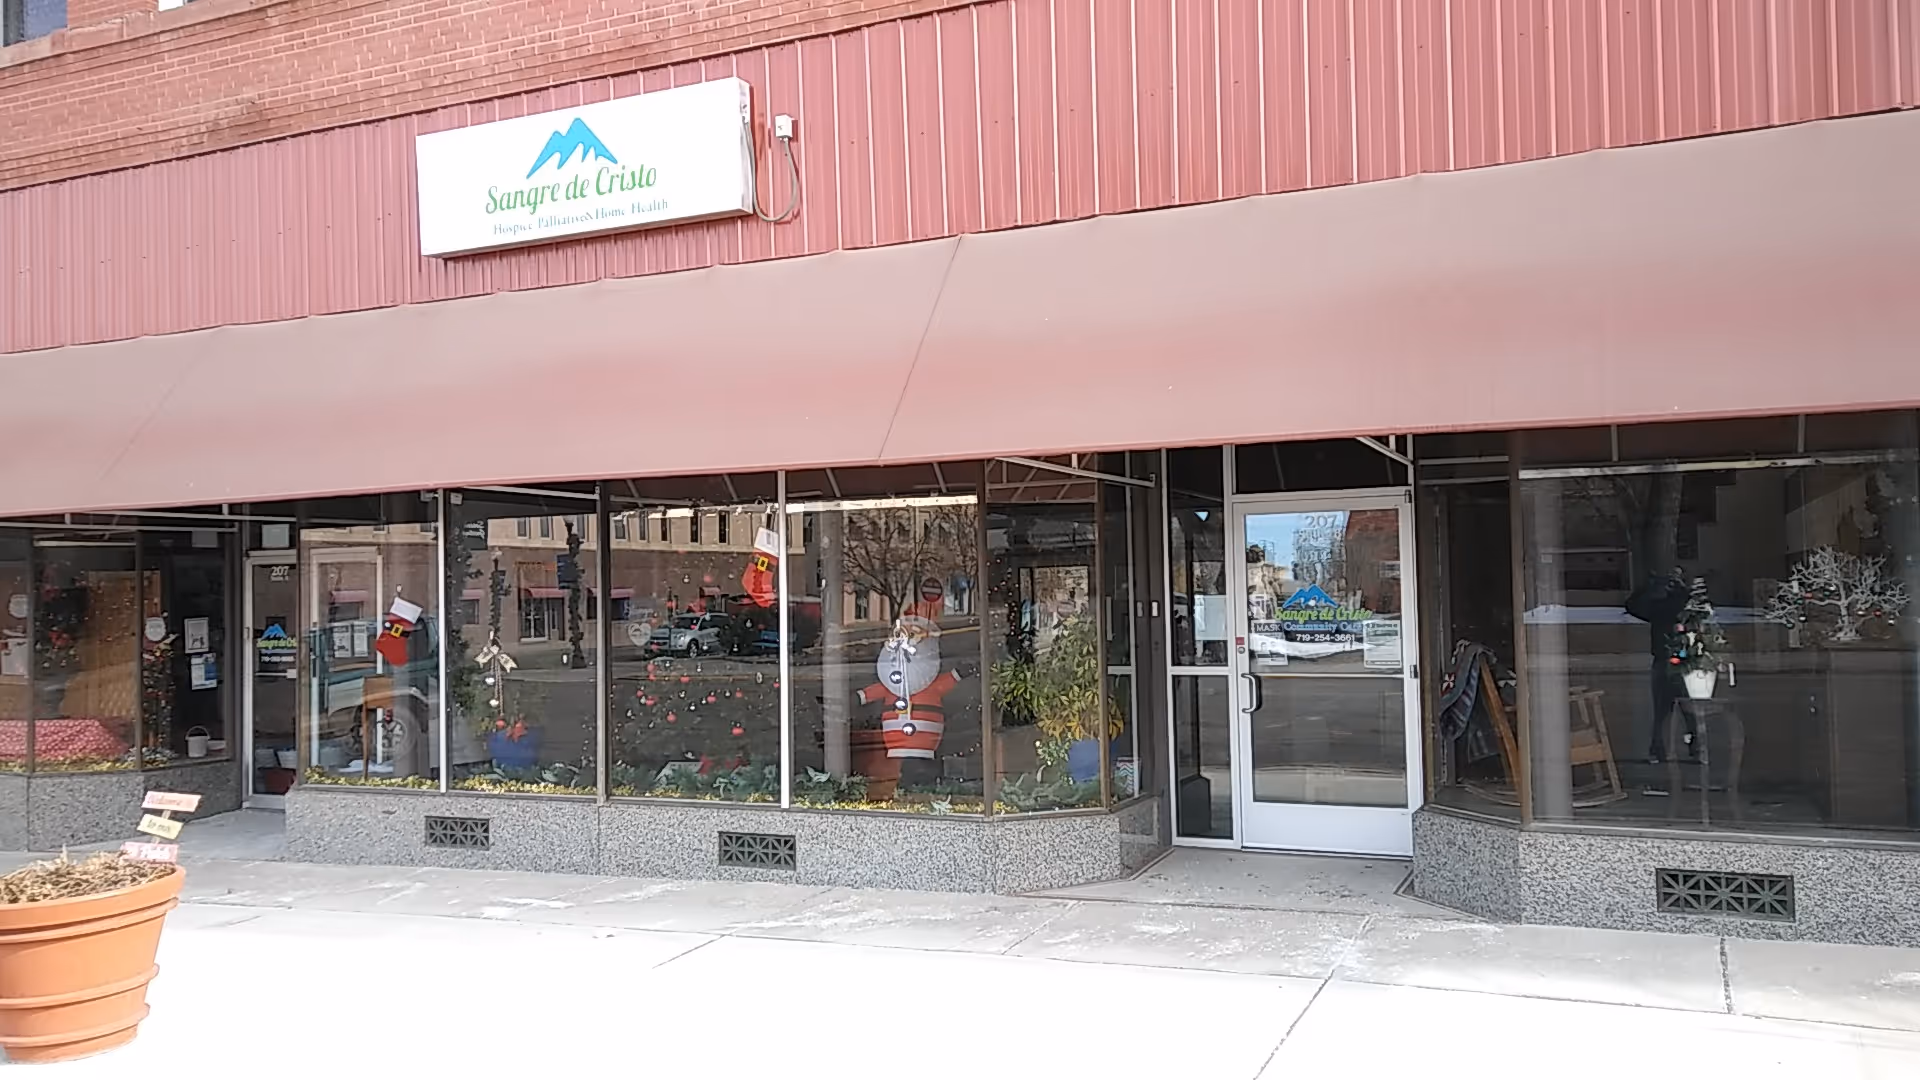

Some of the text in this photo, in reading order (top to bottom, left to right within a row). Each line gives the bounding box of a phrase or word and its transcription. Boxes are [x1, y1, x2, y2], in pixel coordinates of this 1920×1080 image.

[485, 164, 657, 216] Sangre de Cristo
[494, 223, 533, 236] Hospice
[596, 207, 625, 220] Home
[631, 199, 669, 214] Health
[1304, 514, 1338, 528] 207
[271, 566, 289, 576] 207
[1274, 606, 1318, 623] Sangre
[1319, 606, 1335, 620] de
[1257, 624, 1281, 632] MASK
[1284, 621, 1338, 633] Community
[1296, 633, 1355, 642] 719-254-3661
